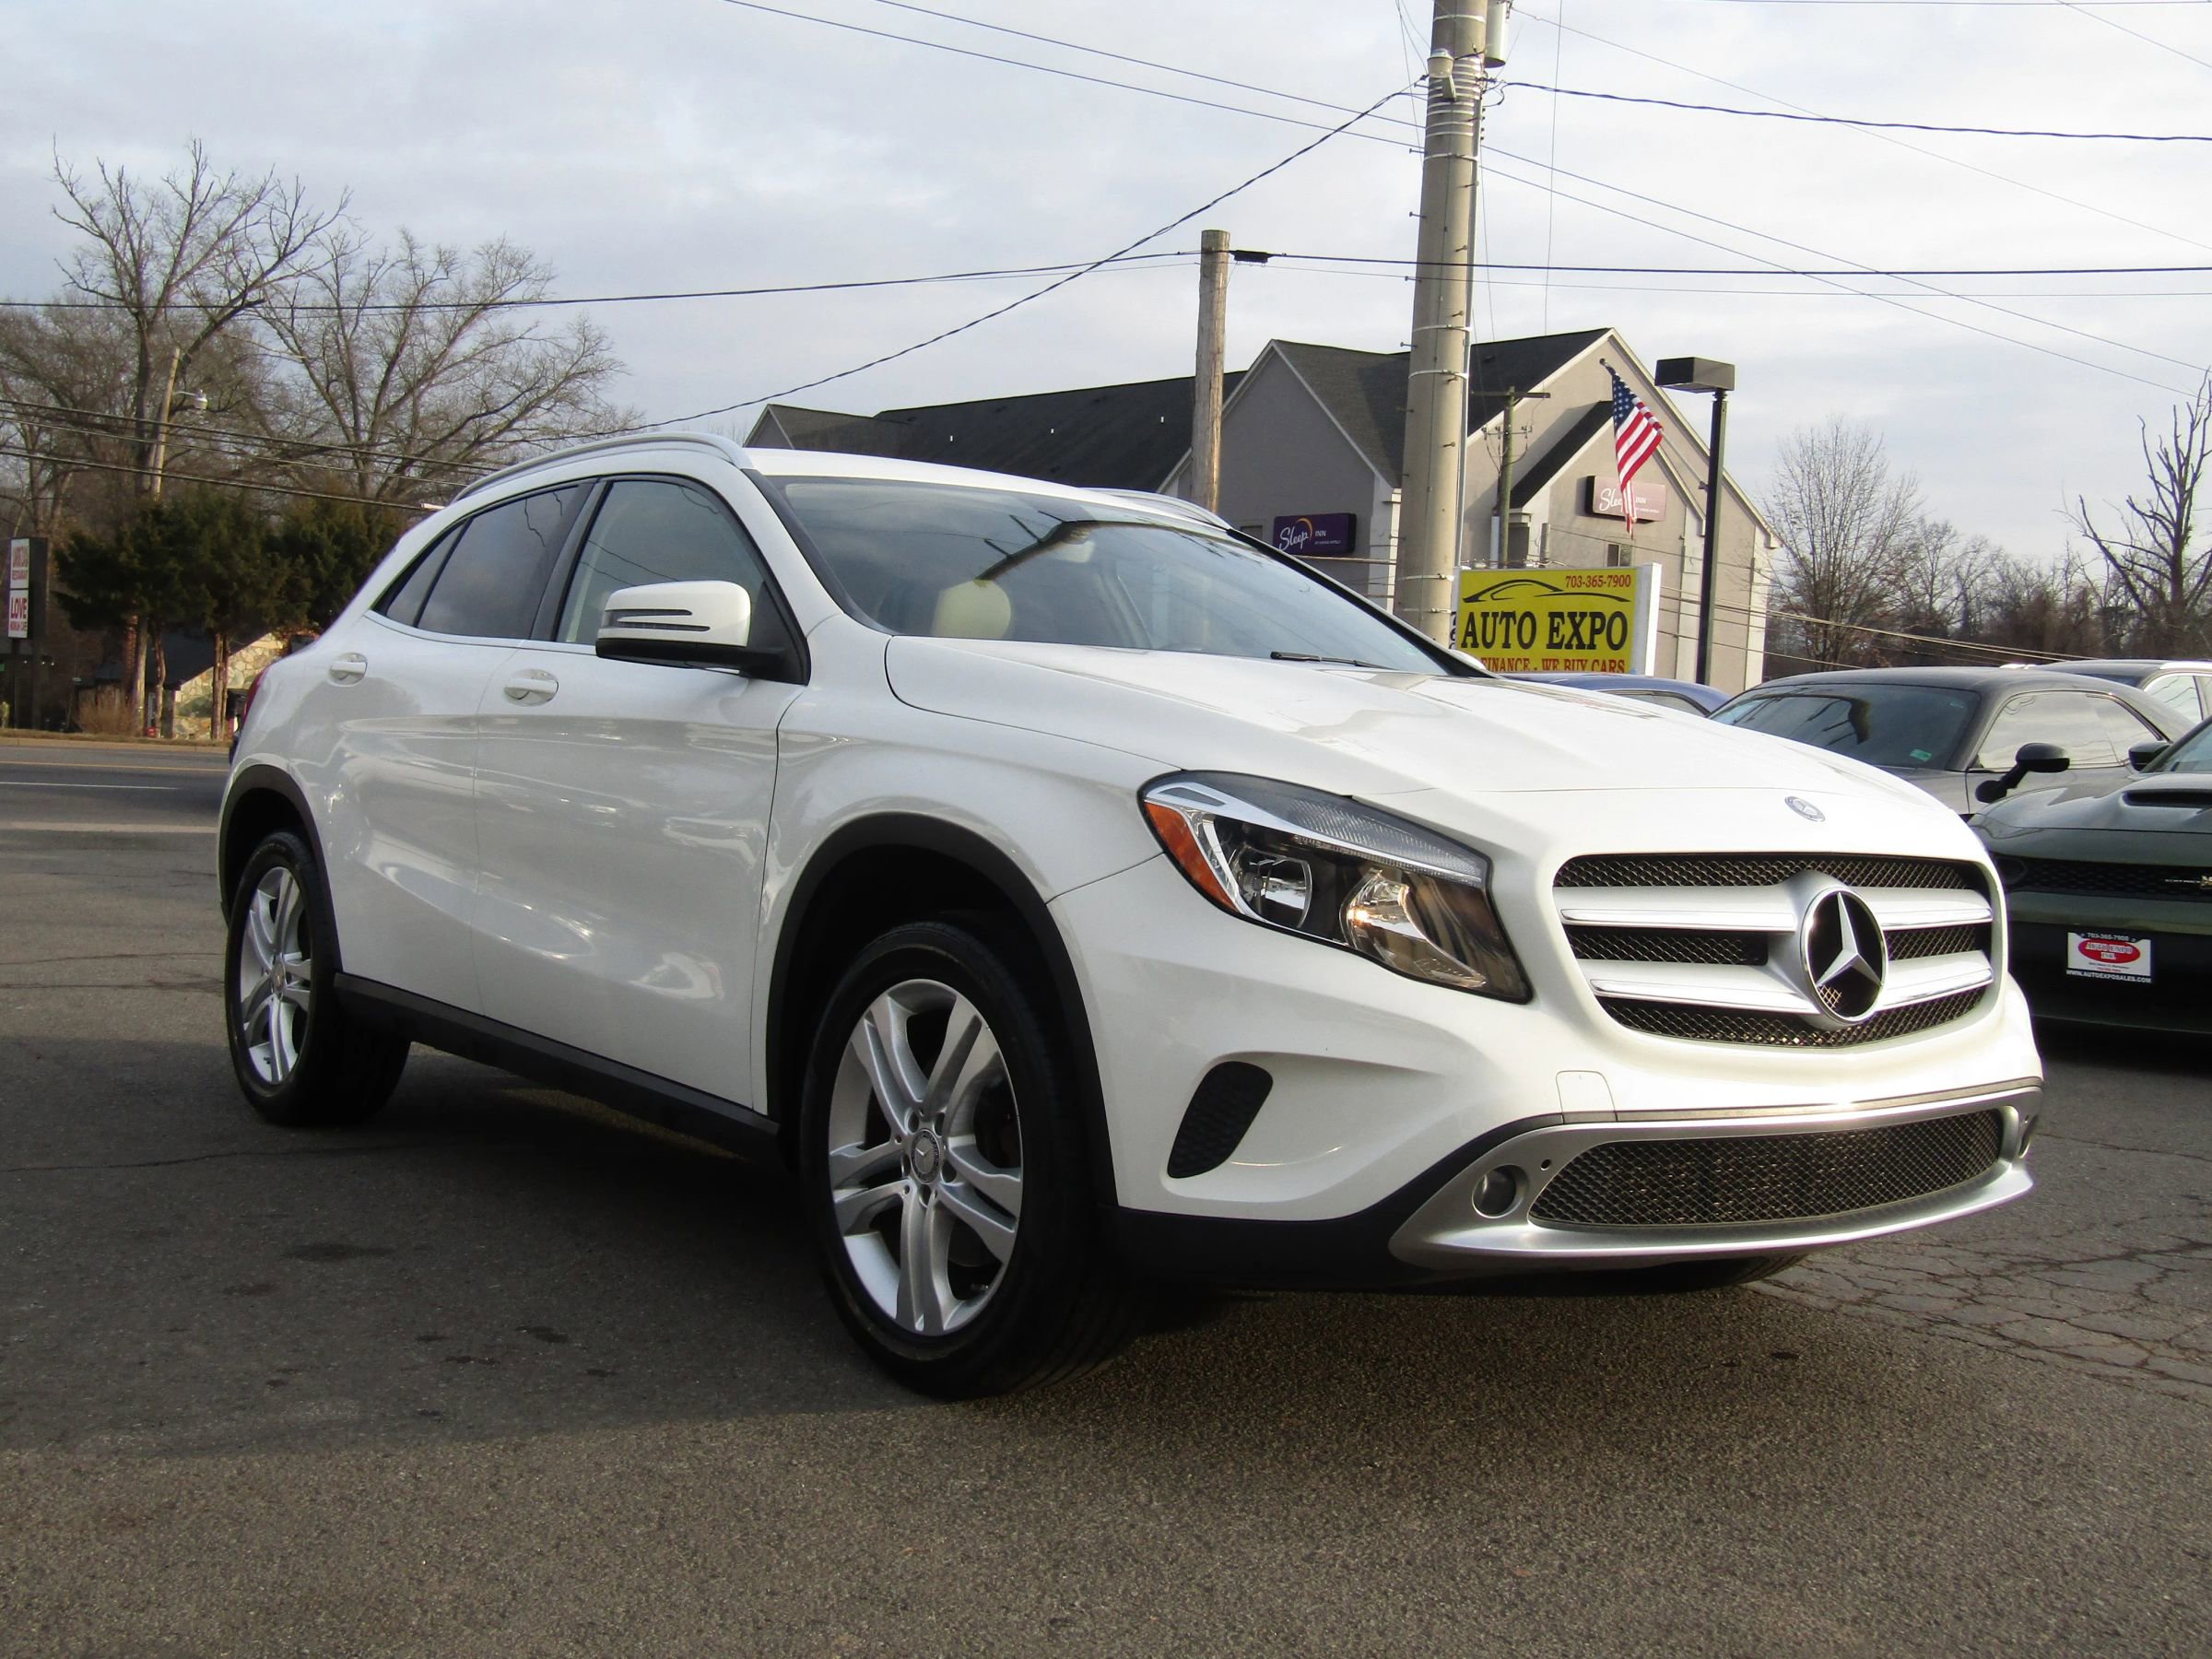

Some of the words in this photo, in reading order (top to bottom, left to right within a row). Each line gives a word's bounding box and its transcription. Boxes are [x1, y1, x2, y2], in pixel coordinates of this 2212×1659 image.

[1599, 488, 1623, 512] Slee
[1278, 525, 1309, 550] Sleep
[1565, 574, 1631, 588] 703-365-7900
[11, 597, 28, 619] LOVE
[1461, 610, 1537, 650] AUTO
[1546, 610, 1629, 651] EXPO
[1480, 657, 1530, 672] FINANCE
[1541, 657, 1559, 671] WE
[1564, 657, 1589, 672] BUY
[1591, 658, 1626, 673] CARS
[2065, 970, 2152, 983] WWW.AUTOEXPOSALES.COM
